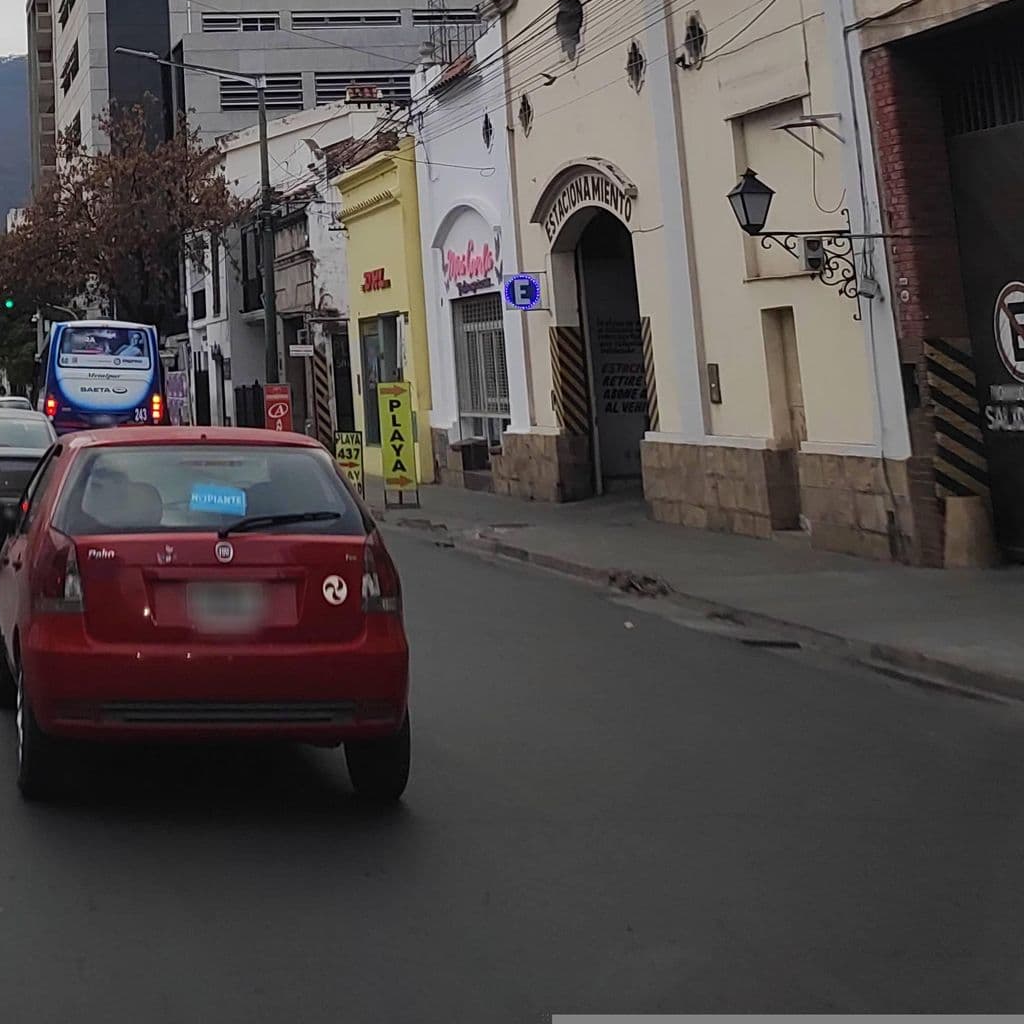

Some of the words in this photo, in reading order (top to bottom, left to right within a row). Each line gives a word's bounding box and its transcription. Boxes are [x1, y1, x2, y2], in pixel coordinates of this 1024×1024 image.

[545, 175, 632, 243] ESTACIONAMIENTO
[362, 267, 391, 293] DHL
[513, 279, 531, 305] E
[135, 408, 147, 421] 243
[335, 433, 361, 445] PLAYA
[389, 399, 407, 472] PLAYA
[338, 448, 360, 460] 437
